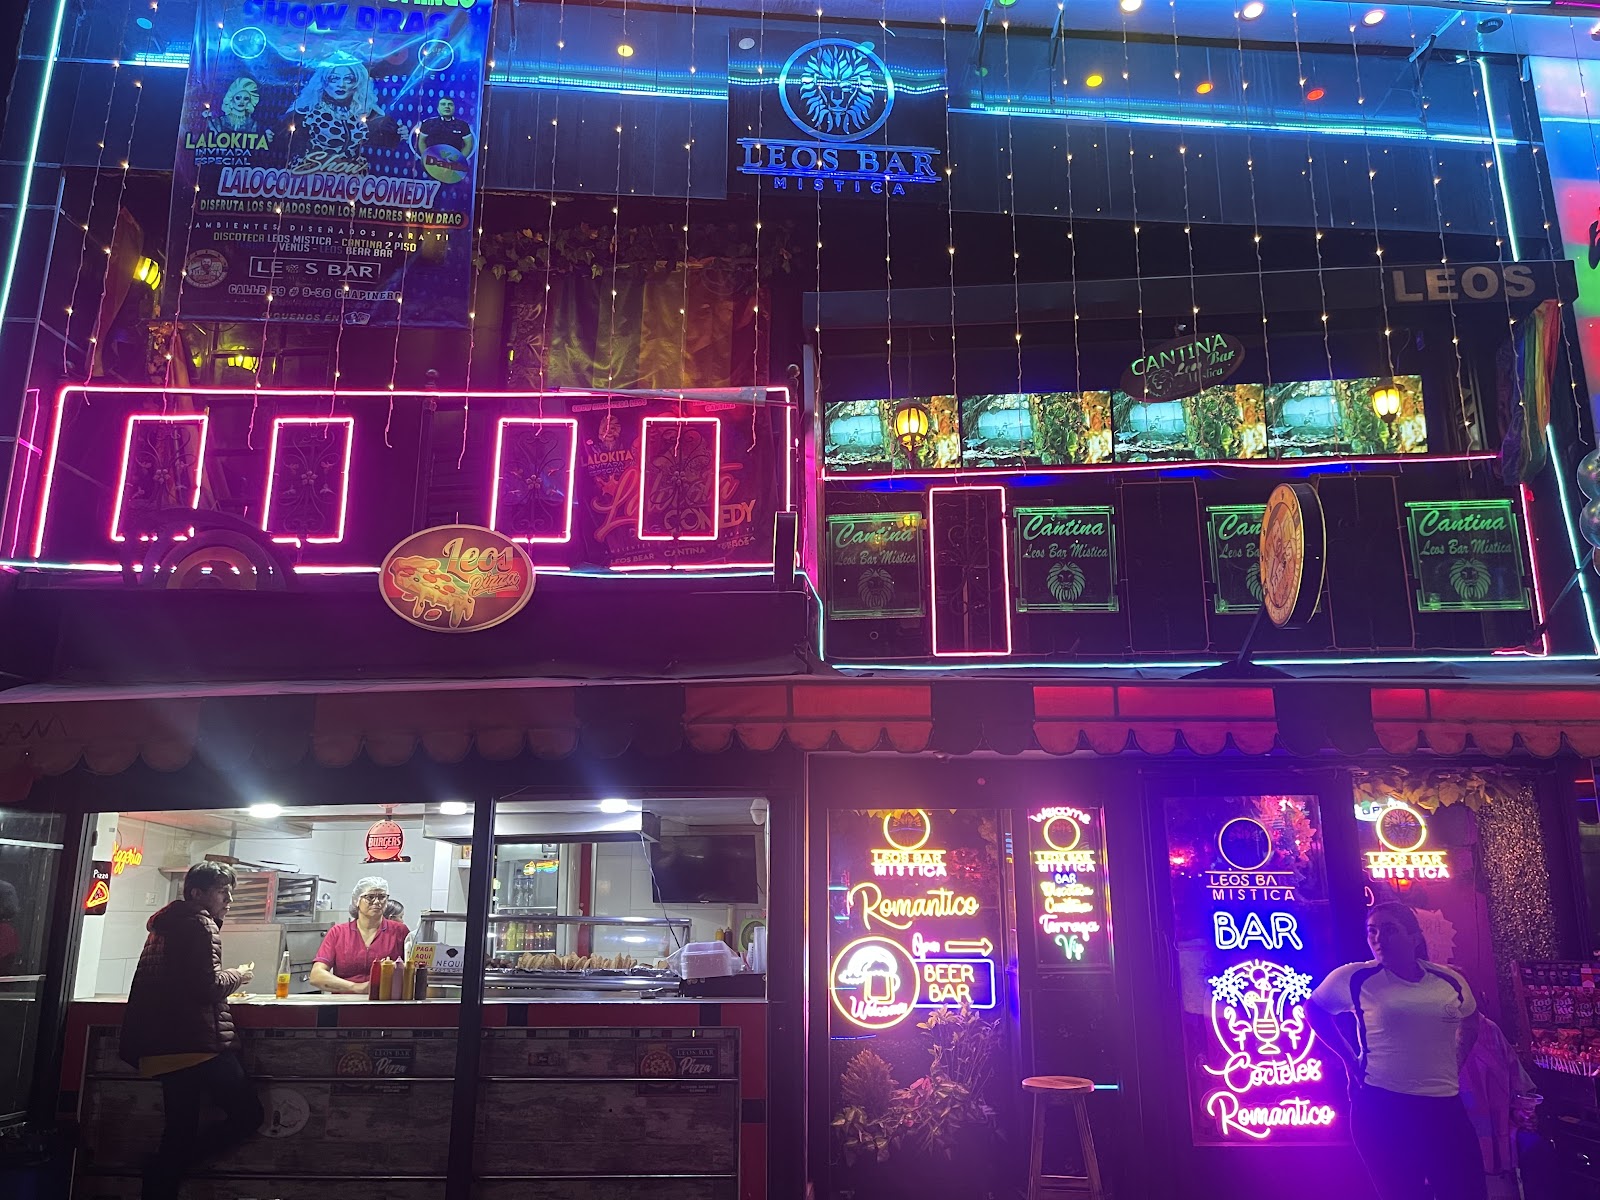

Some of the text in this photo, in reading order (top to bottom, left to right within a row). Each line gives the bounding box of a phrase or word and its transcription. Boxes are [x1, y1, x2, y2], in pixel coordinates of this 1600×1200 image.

[185, 132, 269, 150] LALOKITA
[194, 157, 251, 165] ESPECIAL
[195, 148, 252, 157] INVITADA
[742, 143, 936, 177] LEOS BAR
[291, 152, 369, 175] Show
[309, 174, 360, 202] DRAG
[361, 178, 438, 206] COMEDY
[774, 177, 906, 195] MISTICA
[200, 199, 244, 212] DISFRUTA
[246, 201, 264, 212] LOS
[313, 204, 336, 216] CON
[338, 205, 355, 218] LOS
[358, 207, 403, 221] MEJORES
[436, 213, 461, 225] DRAG
[195, 222, 280, 231] AMBIENTES
[290, 224, 376, 237] DISEÑADOS
[388, 231, 424, 241] PARA
[213, 231, 417, 252] DISCOTECA LEOS MISTICA CANTINA 2 PISO
[279, 243, 310, 253] VENUS
[346, 247, 371, 257] BEAR
[373, 249, 393, 258] BAR
[327, 264, 373, 278] BAR
[229, 284, 267, 295] CALLE
[271, 286, 286, 297] 59
[302, 286, 331, 298] 9-36
[334, 288, 401, 301] CHAPINERO
[1393, 265, 1536, 303] LEOS
[1131, 333, 1228, 376] CANTINA
[1206, 350, 1236, 366] Bar
[1023, 515, 1106, 540] Cantina
[1419, 510, 1507, 537] Cantina
[835, 523, 914, 548] Cantina
[1022, 543, 1046, 558] Leos
[1048, 543, 1067, 559] Bar
[1219, 543, 1242, 559] Leos
[1420, 540, 1445, 555] Leos
[1447, 538, 1469, 555] Bar
[443, 537, 513, 583] Leos
[859, 550, 878, 565] Bar
[873, 852, 943, 864] LEOS BAR
[1410, 854, 1442, 866] BAR
[93, 869, 109, 879] Pizza
[873, 865, 947, 877] MISTICA
[1054, 873, 1077, 884] BAR
[1372, 867, 1450, 879] MISTICA
[1210, 875, 1250, 887] LEOS
[1212, 889, 1295, 901] MISTICA
[847, 882, 979, 930] Romantico
[1213, 911, 1303, 950] BAR
[435, 960, 463, 968] NEQUI
[924, 964, 975, 983] BEER
[929, 984, 973, 1003] BAR
[698, 1049, 715, 1057] BAR
[375, 1057, 408, 1075] Pizza
[680, 1056, 712, 1075] Pizza
[1207, 1091, 1335, 1138] Romantico
